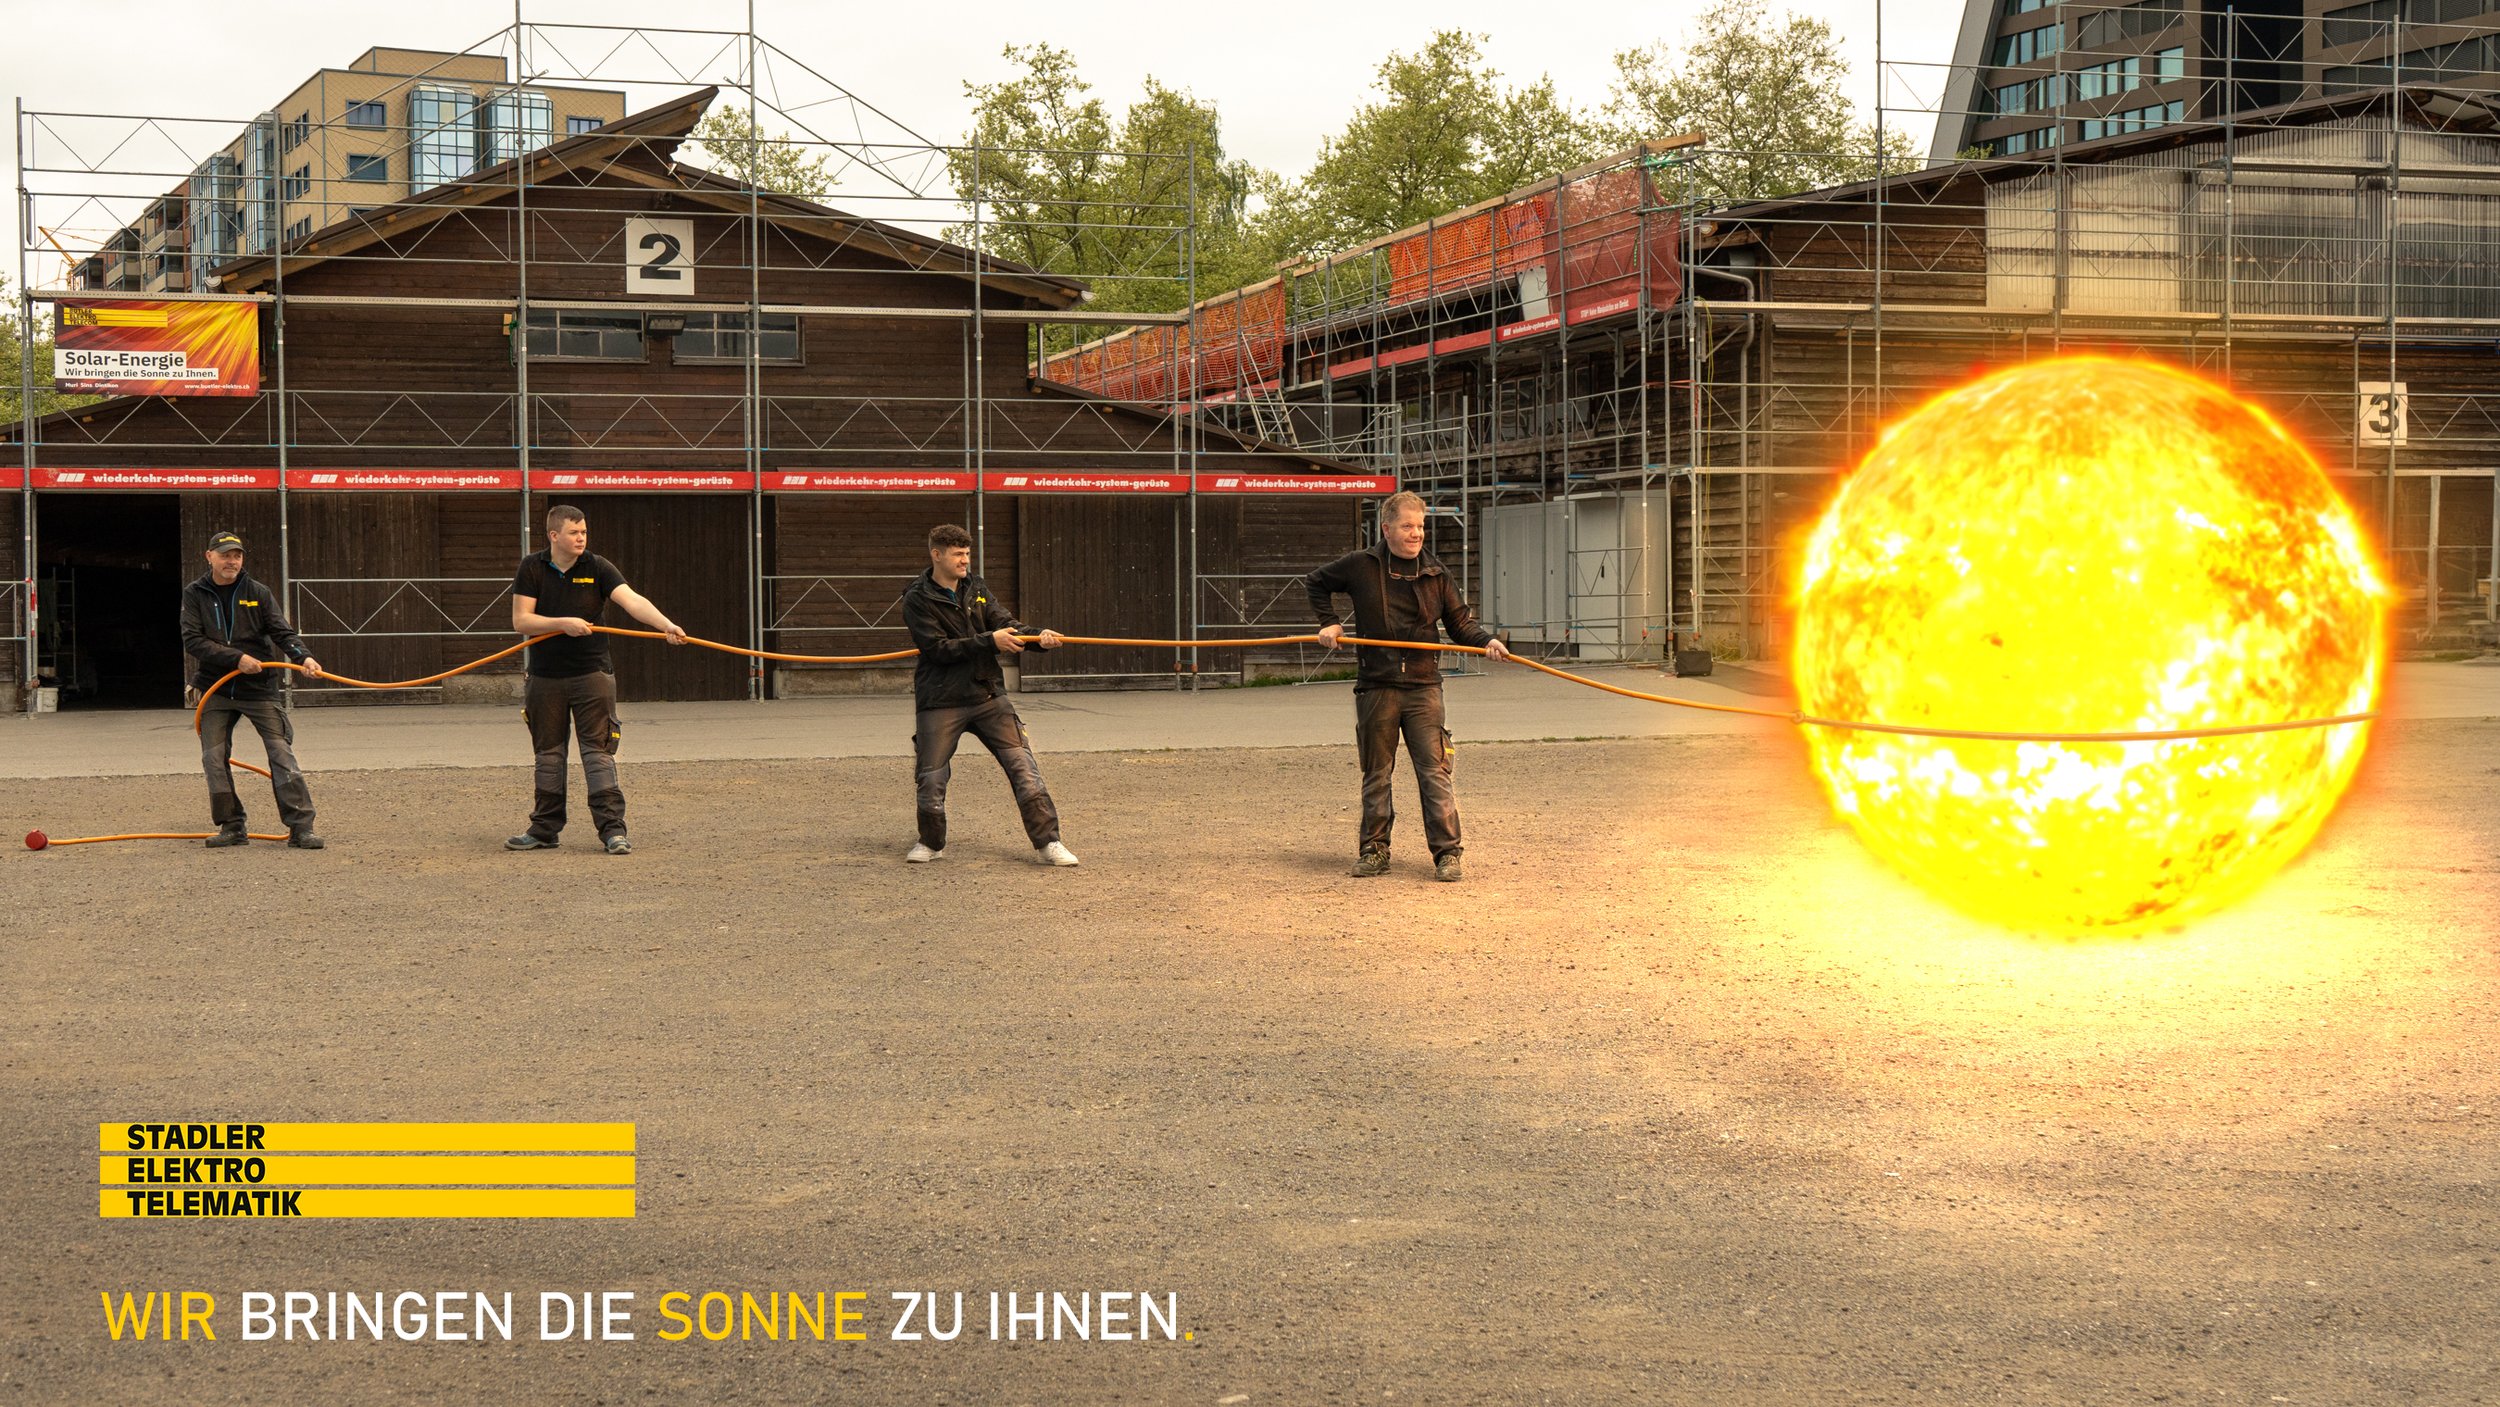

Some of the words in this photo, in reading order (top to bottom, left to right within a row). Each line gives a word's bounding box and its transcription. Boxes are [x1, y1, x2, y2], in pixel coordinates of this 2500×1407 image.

[639, 233, 682, 280] 2
[65, 351, 184, 370] Solar-Energie
[65, 368, 81, 376] Wir
[84, 368, 121, 378] bringen
[123, 369, 138, 377] die
[140, 369, 170, 378] Sonne
[186, 370, 216, 378] Ihnen.
[2368, 392, 2400, 434] 3
[92, 473, 256, 485] wiederkehr-system-gerüste
[344, 474, 500, 486] wiederkehr-system-gerüste
[584, 475, 733, 486] wiederkehr-system-gerüste
[813, 476, 956, 487] wiederkehr-system-gerüste
[1033, 478, 1170, 489] wiederkehr-system-gerüste
[1244, 479, 1376, 490] wiederkehr-system-gerüste
